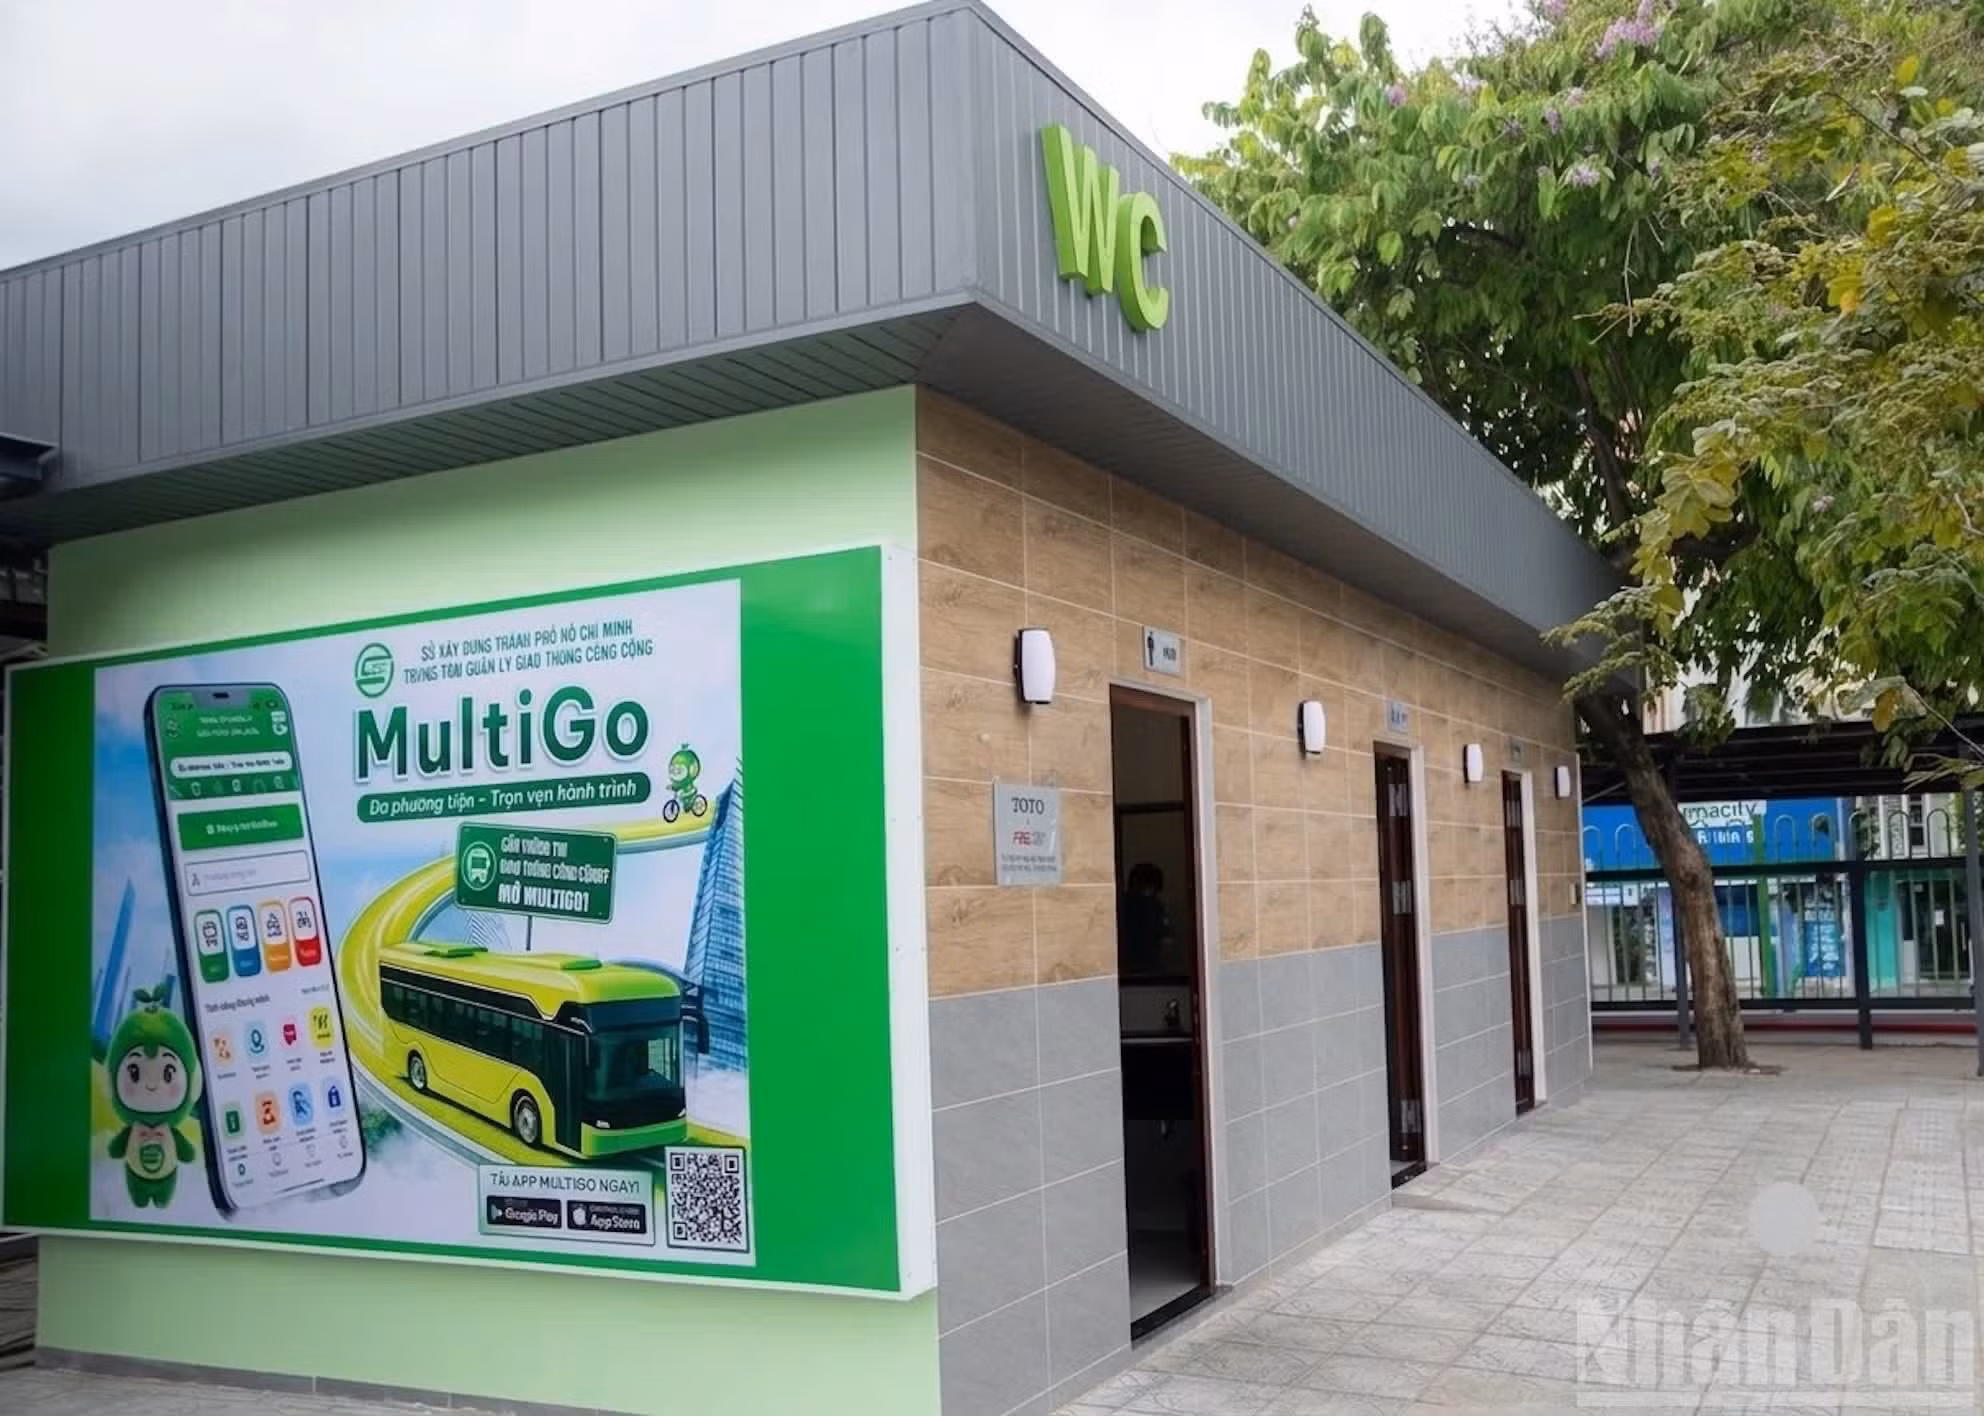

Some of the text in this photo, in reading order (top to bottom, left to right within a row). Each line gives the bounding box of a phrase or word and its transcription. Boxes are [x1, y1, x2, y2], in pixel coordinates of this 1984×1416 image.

[1041, 124, 1169, 334] WC
[602, 618, 633, 638] MINH
[356, 685, 650, 780] MultiGo
[490, 788, 523, 810] Trọn
[527, 788, 553, 807] vẹn
[599, 777, 637, 799] trình
[1011, 797, 1045, 815] TOTO
[512, 1174, 537, 1187] APP
